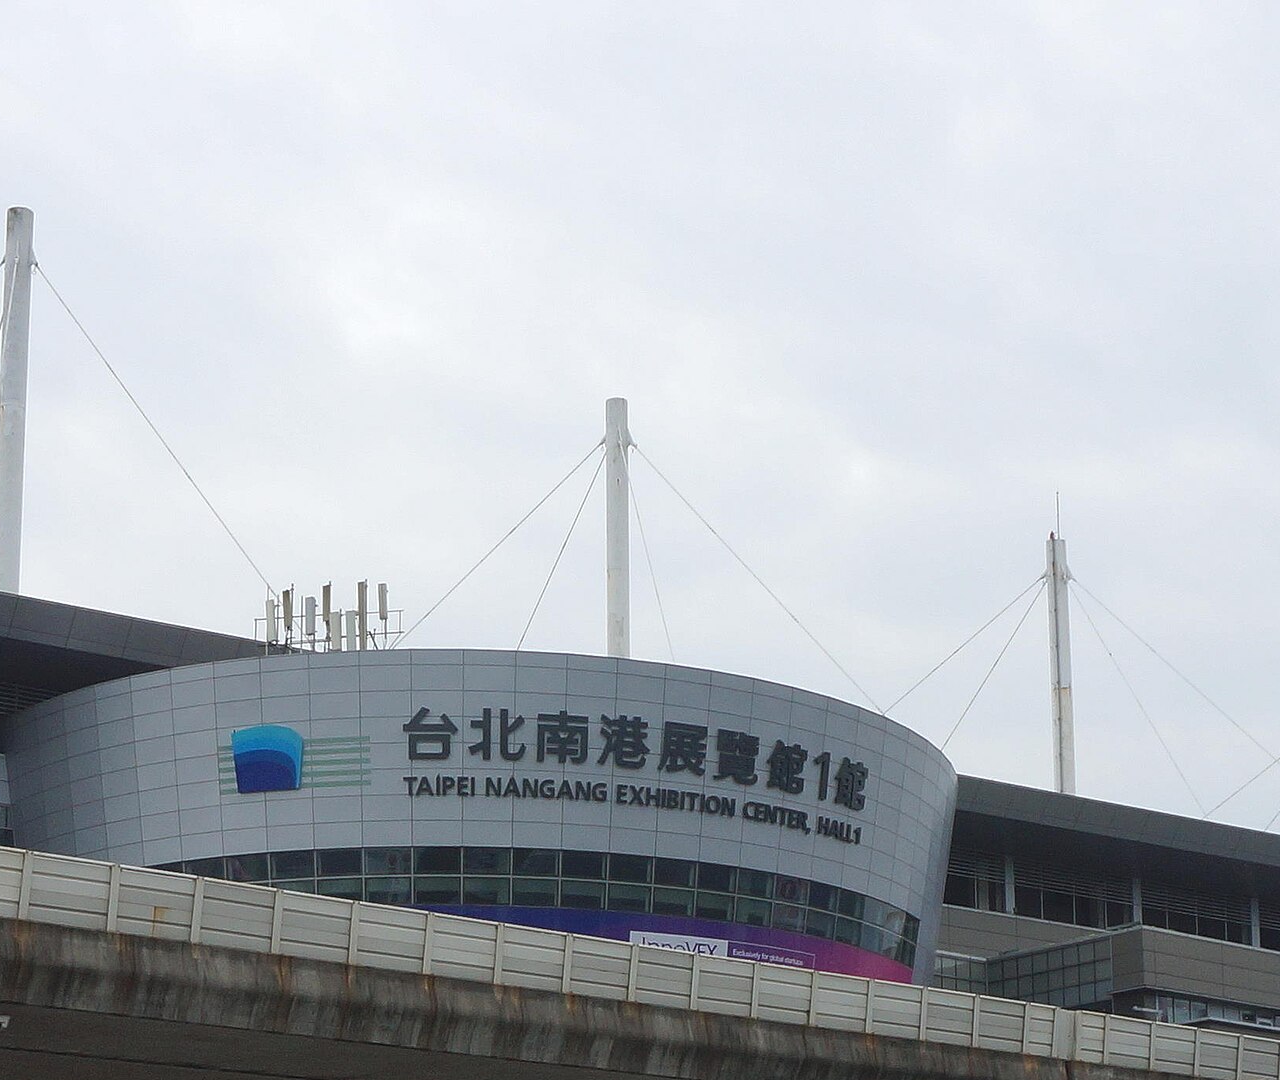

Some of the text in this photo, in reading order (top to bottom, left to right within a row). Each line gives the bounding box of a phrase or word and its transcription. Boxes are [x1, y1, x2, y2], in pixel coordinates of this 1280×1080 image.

[403, 706, 869, 811] 台北南港展覽館1館
[403, 774, 475, 798] TAIPEI
[485, 776, 608, 802] NANGANG
[616, 784, 736, 818] EXHIBITION
[743, 801, 811, 834] CENTER,
[732, 948, 760, 960] Exclusively
[761, 952, 769, 960] for
